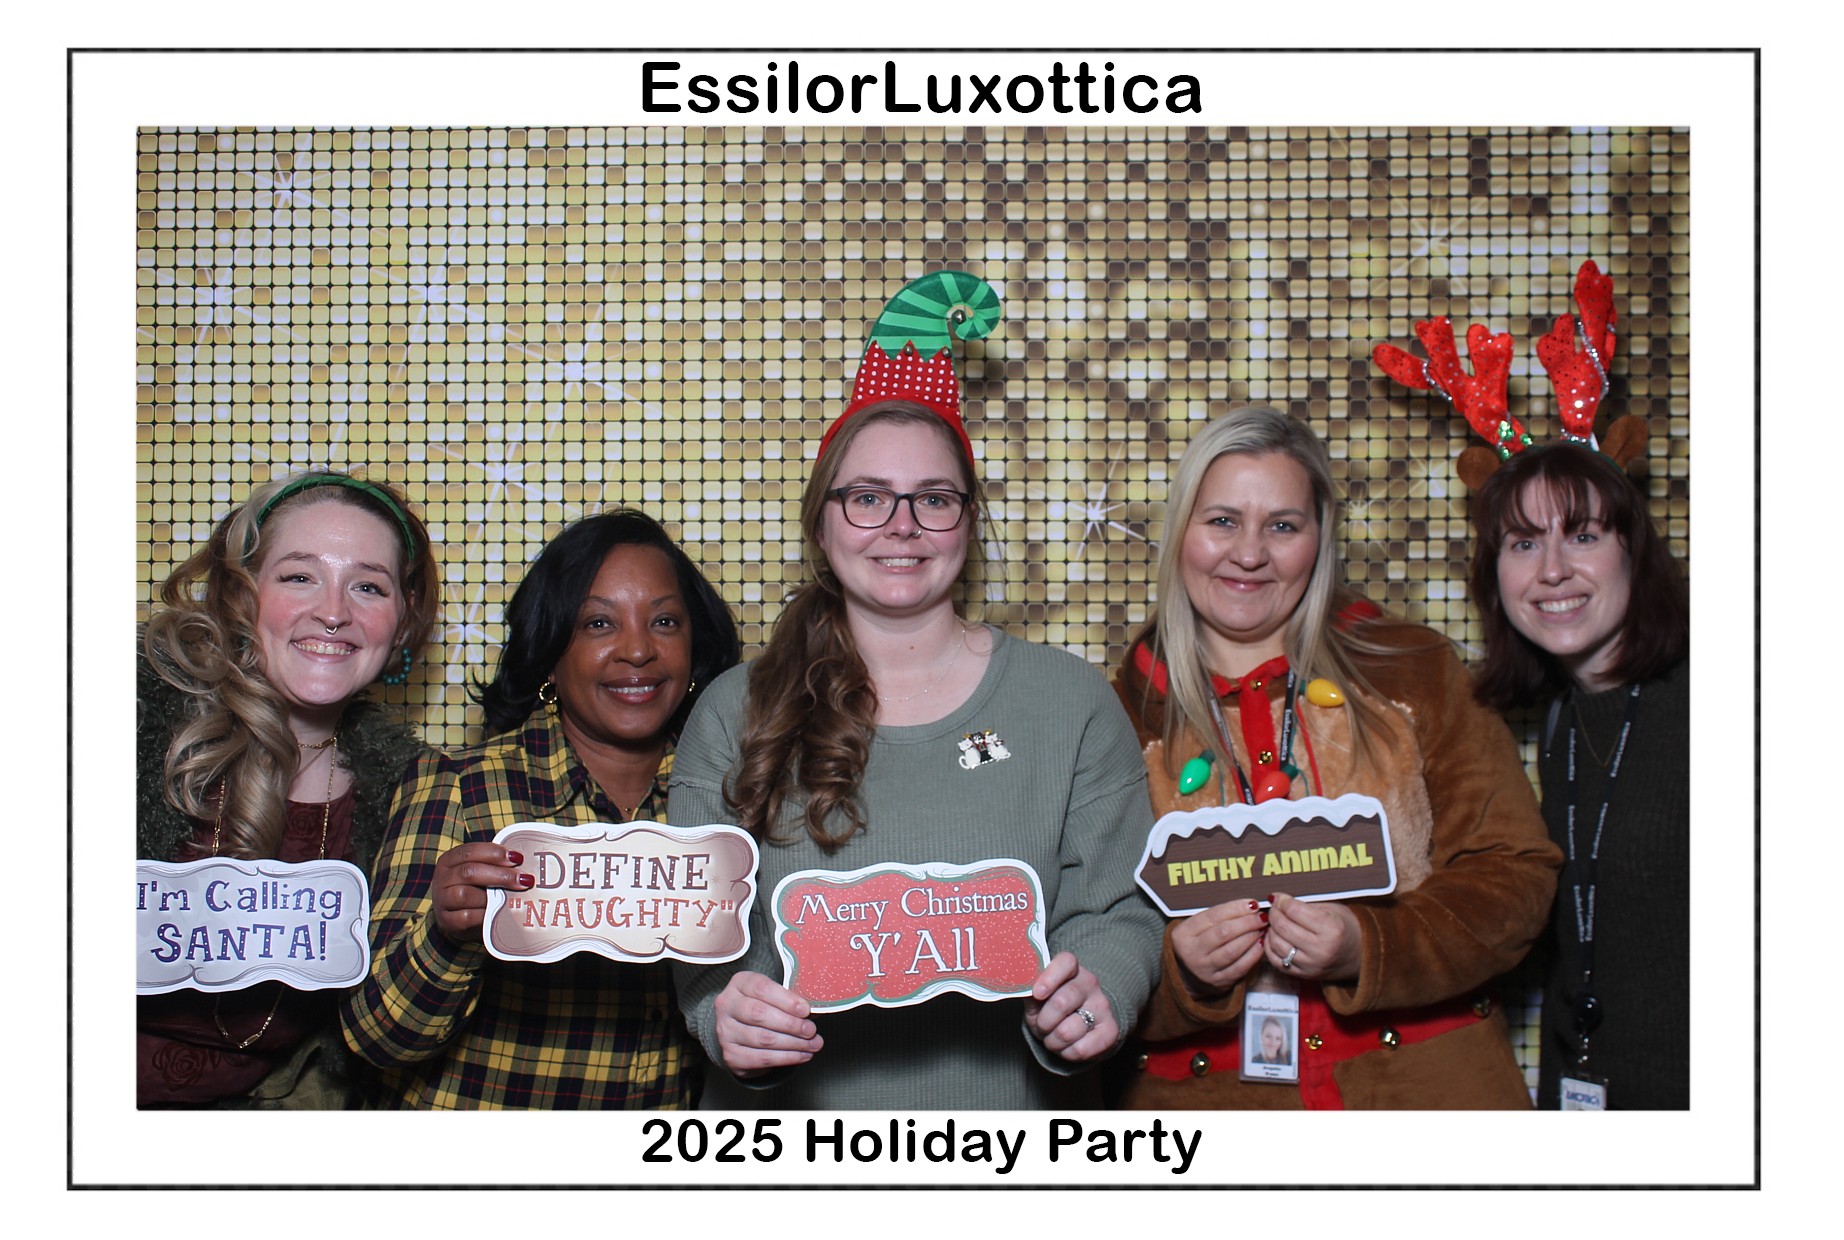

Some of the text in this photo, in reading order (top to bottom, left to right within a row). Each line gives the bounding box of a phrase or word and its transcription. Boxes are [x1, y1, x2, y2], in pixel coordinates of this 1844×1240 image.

[534, 851, 711, 891] DEFINE
[1167, 855, 1256, 887] FILTHY
[136, 880, 343, 920] I'm Calling
[508, 896, 734, 929] "NAUGHTY"
[795, 886, 1029, 931] Merry Christmas
[150, 920, 327, 963] SANTA!
[849, 926, 980, 978] Y'All
